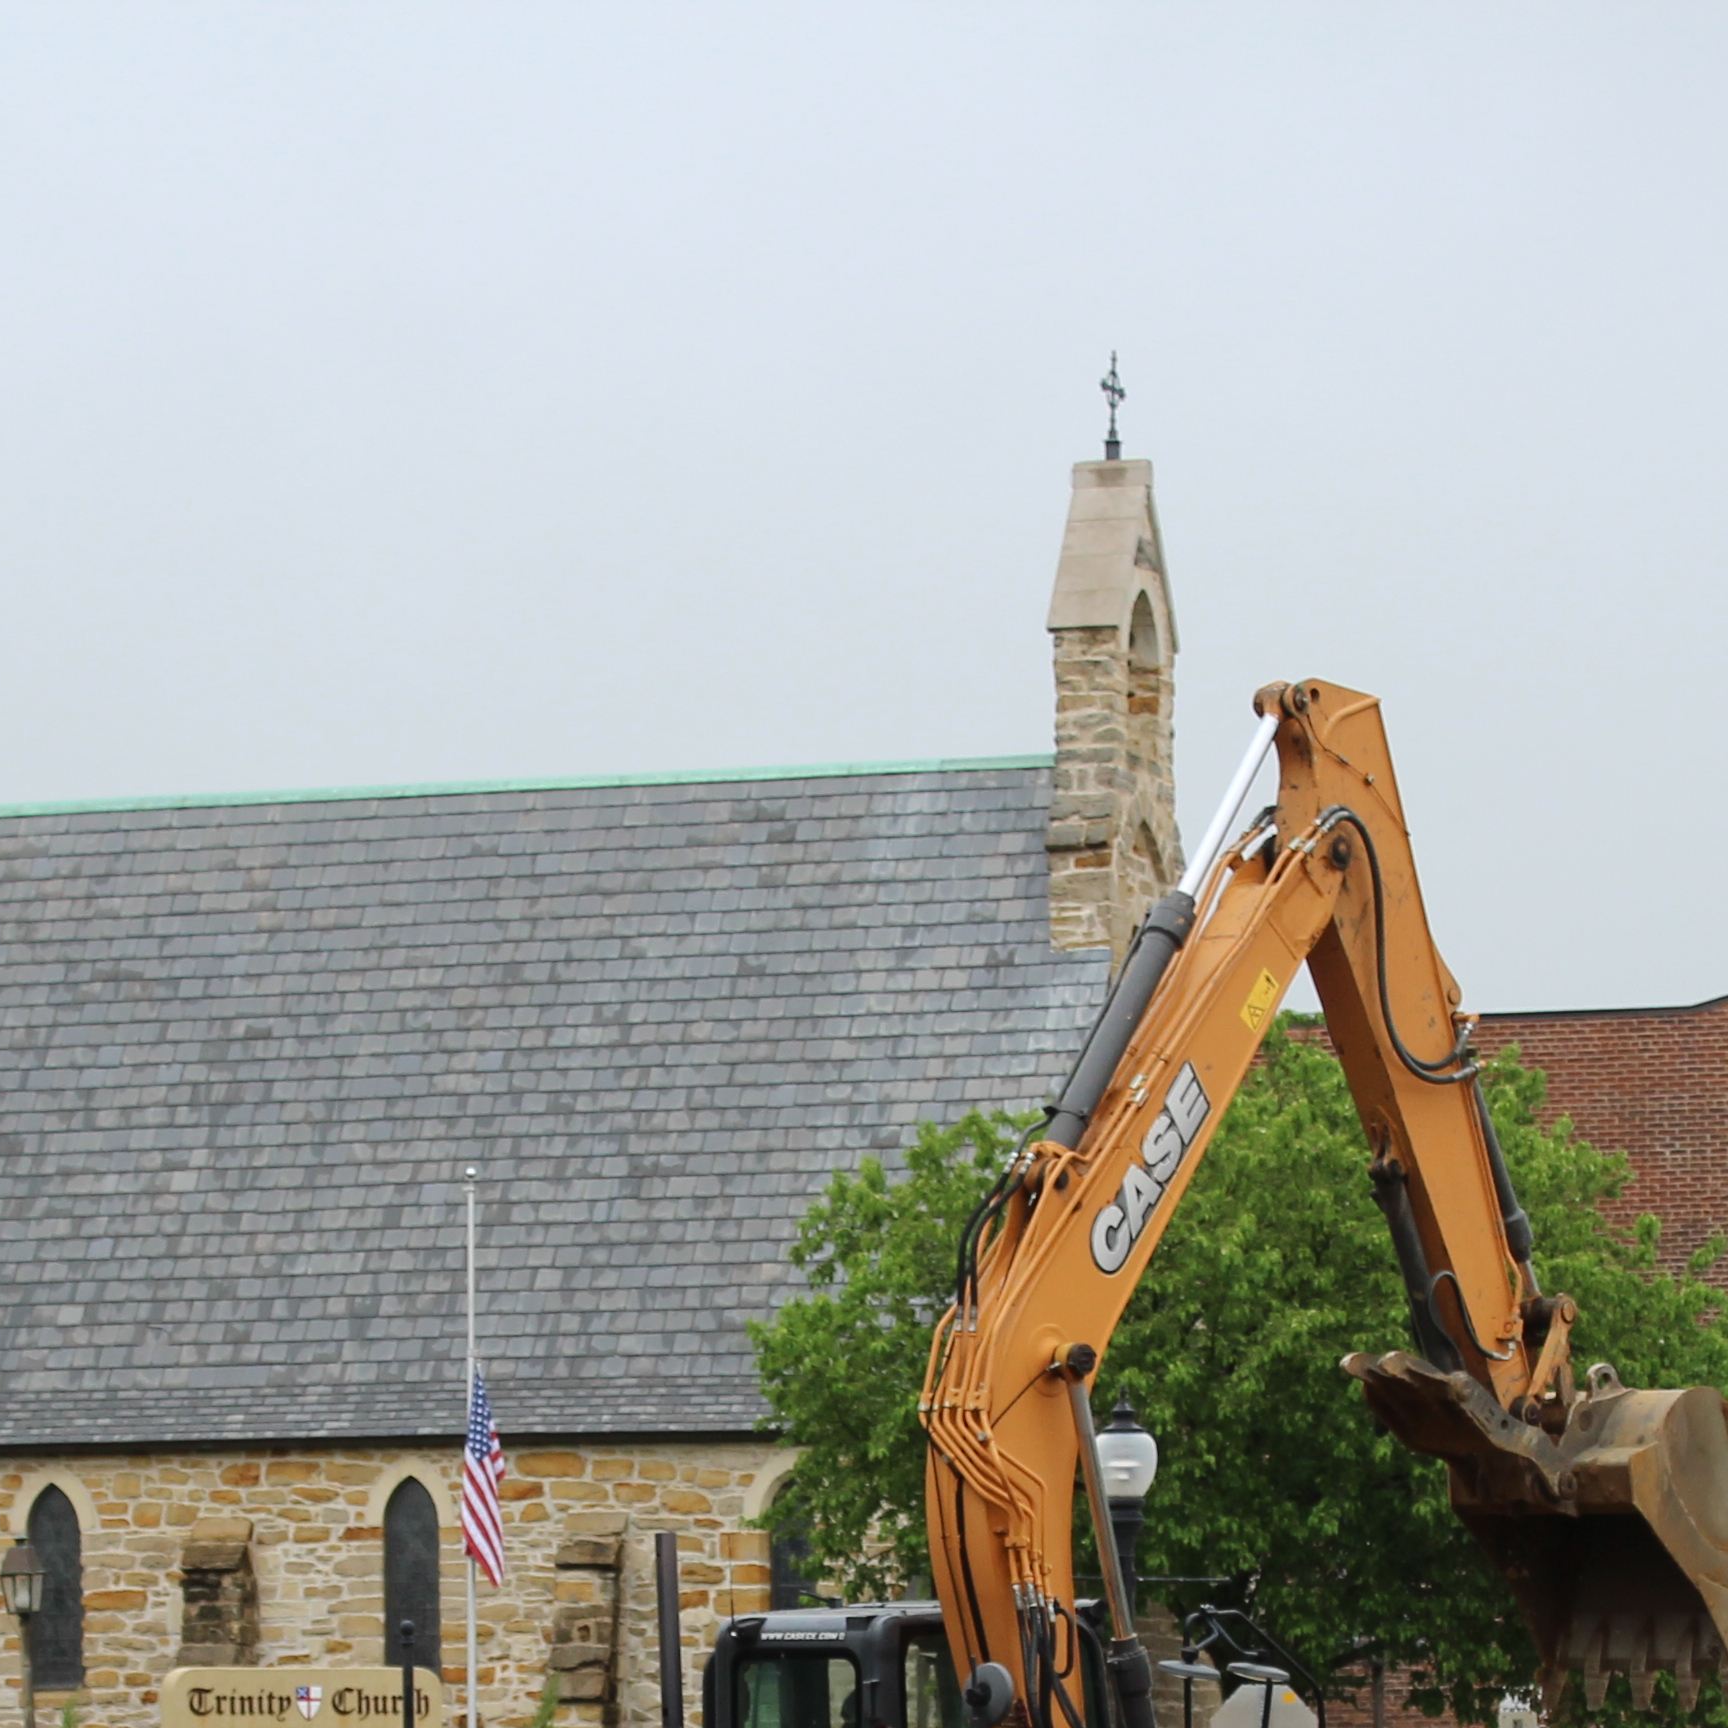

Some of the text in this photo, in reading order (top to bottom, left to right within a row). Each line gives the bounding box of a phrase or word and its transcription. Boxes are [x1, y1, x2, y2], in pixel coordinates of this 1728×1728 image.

[1091, 1060, 1210, 1274] CASE
[187, 1687, 430, 1722] Trinity Churh
